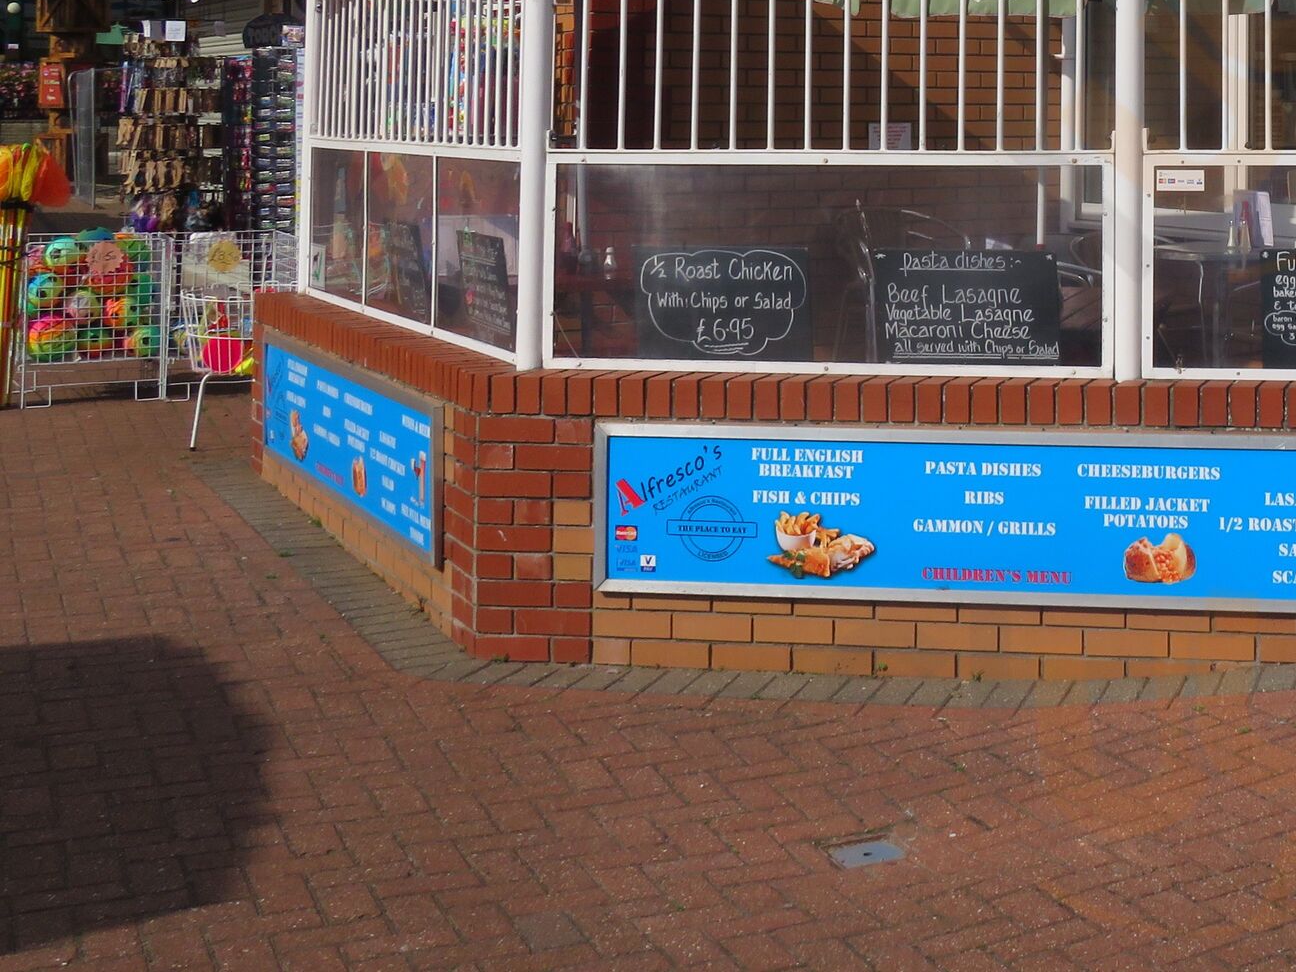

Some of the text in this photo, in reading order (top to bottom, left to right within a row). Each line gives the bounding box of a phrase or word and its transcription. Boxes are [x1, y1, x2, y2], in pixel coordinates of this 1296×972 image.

[954, 251, 1005, 270] dishes
[675, 257, 793, 281] Roast Chicken
[1276, 275, 1295, 290] egg
[691, 292, 727, 313] Chips
[735, 296, 749, 307] or
[754, 292, 792, 311] Salad
[887, 283, 1021, 310] Beef Lasagne
[959, 303, 1034, 329] Lasagne
[886, 319, 1032, 340] Macaroni Cheese
[752, 448, 863, 463] FULL ENGLISH
[760, 464, 854, 478] BREAKFAST
[926, 461, 1041, 476] PASTA DISHES
[1078, 464, 1220, 480] CHEESEBURGERS
[616, 445, 722, 516] Alfresco's
[753, 490, 860, 505] FISH & CHIPS
[965, 491, 1004, 504] RIBS
[1085, 496, 1210, 512] FILLED JACKET
[913, 519, 983, 533] GAMMON
[998, 522, 1055, 535] GRILLS
[1104, 514, 1188, 528] POTATOES
[1220, 517, 1242, 531] 1/2
[922, 566, 1072, 586] CHILDREN'S MENU
